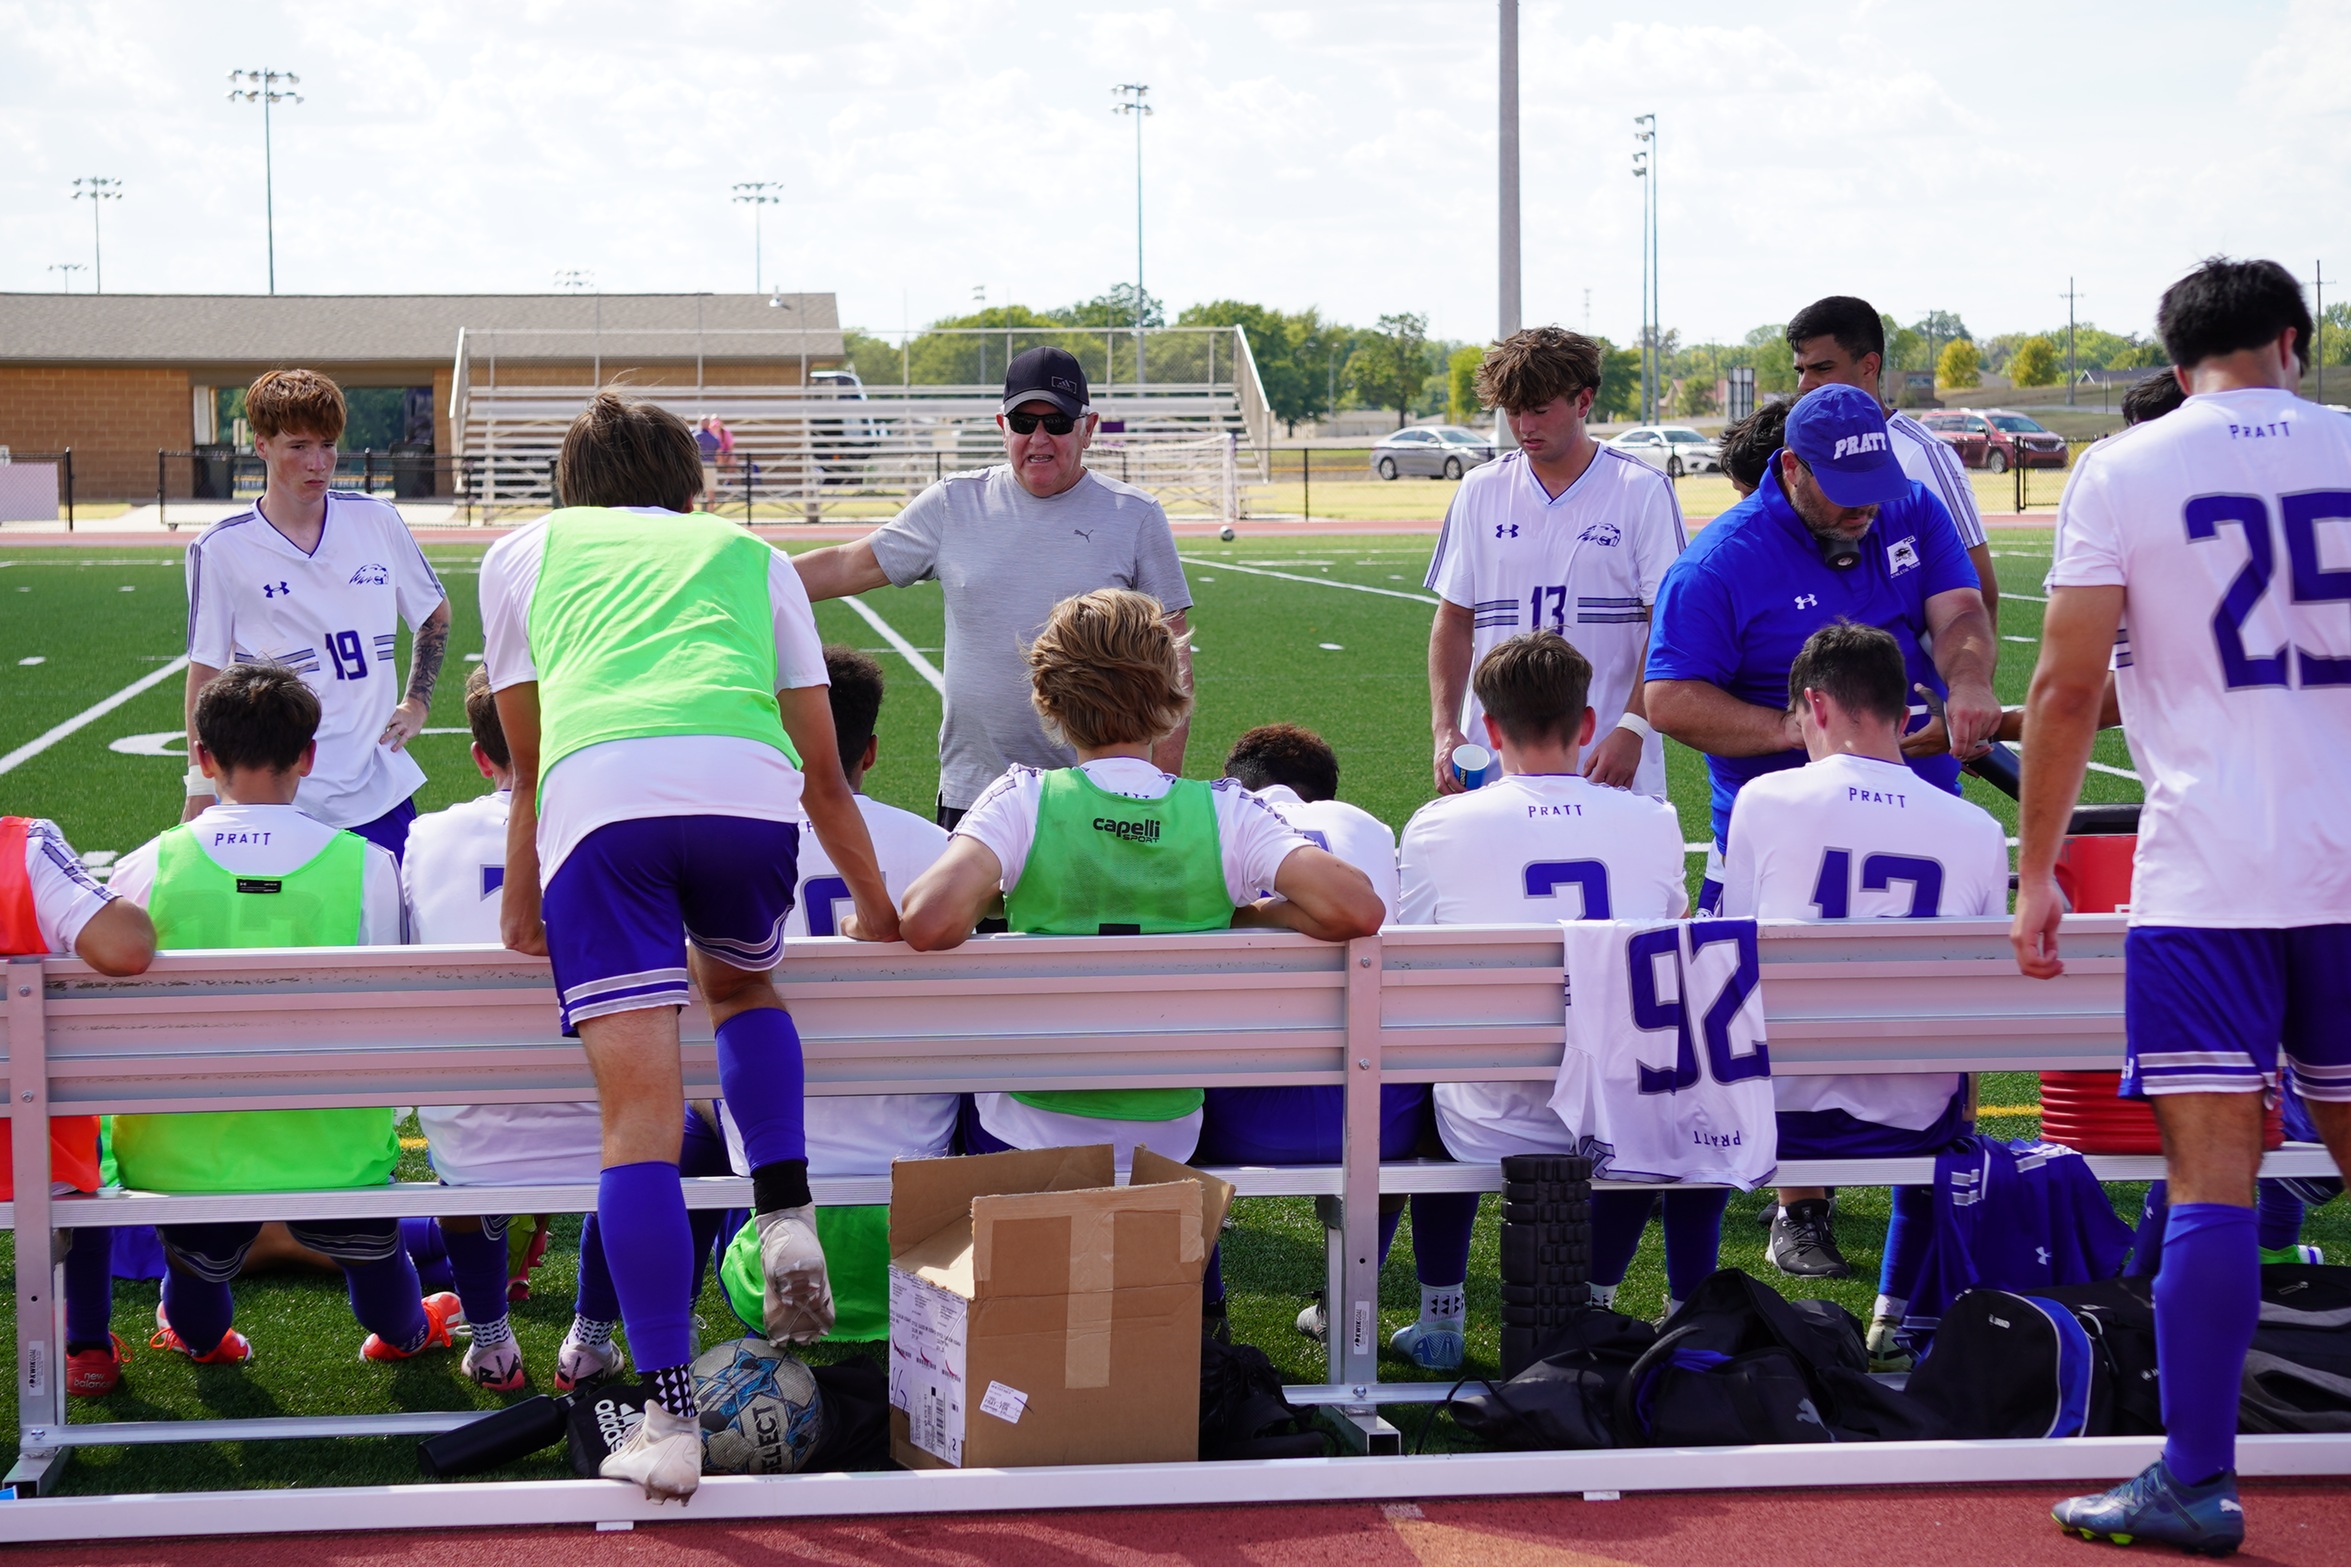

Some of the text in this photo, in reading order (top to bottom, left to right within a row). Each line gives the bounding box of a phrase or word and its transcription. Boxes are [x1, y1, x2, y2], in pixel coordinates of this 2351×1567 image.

[2229, 422, 2290, 439] PRATT
[1833, 432, 1887, 460] PRATT
[2181, 487, 2351, 693] 25
[1530, 585, 1567, 636] 13
[324, 629, 368, 681] 19
[1848, 786, 1906, 809] PRATT
[1527, 804, 1583, 818] PRATT
[1092, 817, 1161, 838] capelli
[214, 832, 272, 847] PRATT
[1122, 833, 1160, 844] SPORT
[1693, 1129, 1743, 1147] PRATT
[83, 1372, 105, 1381] new
